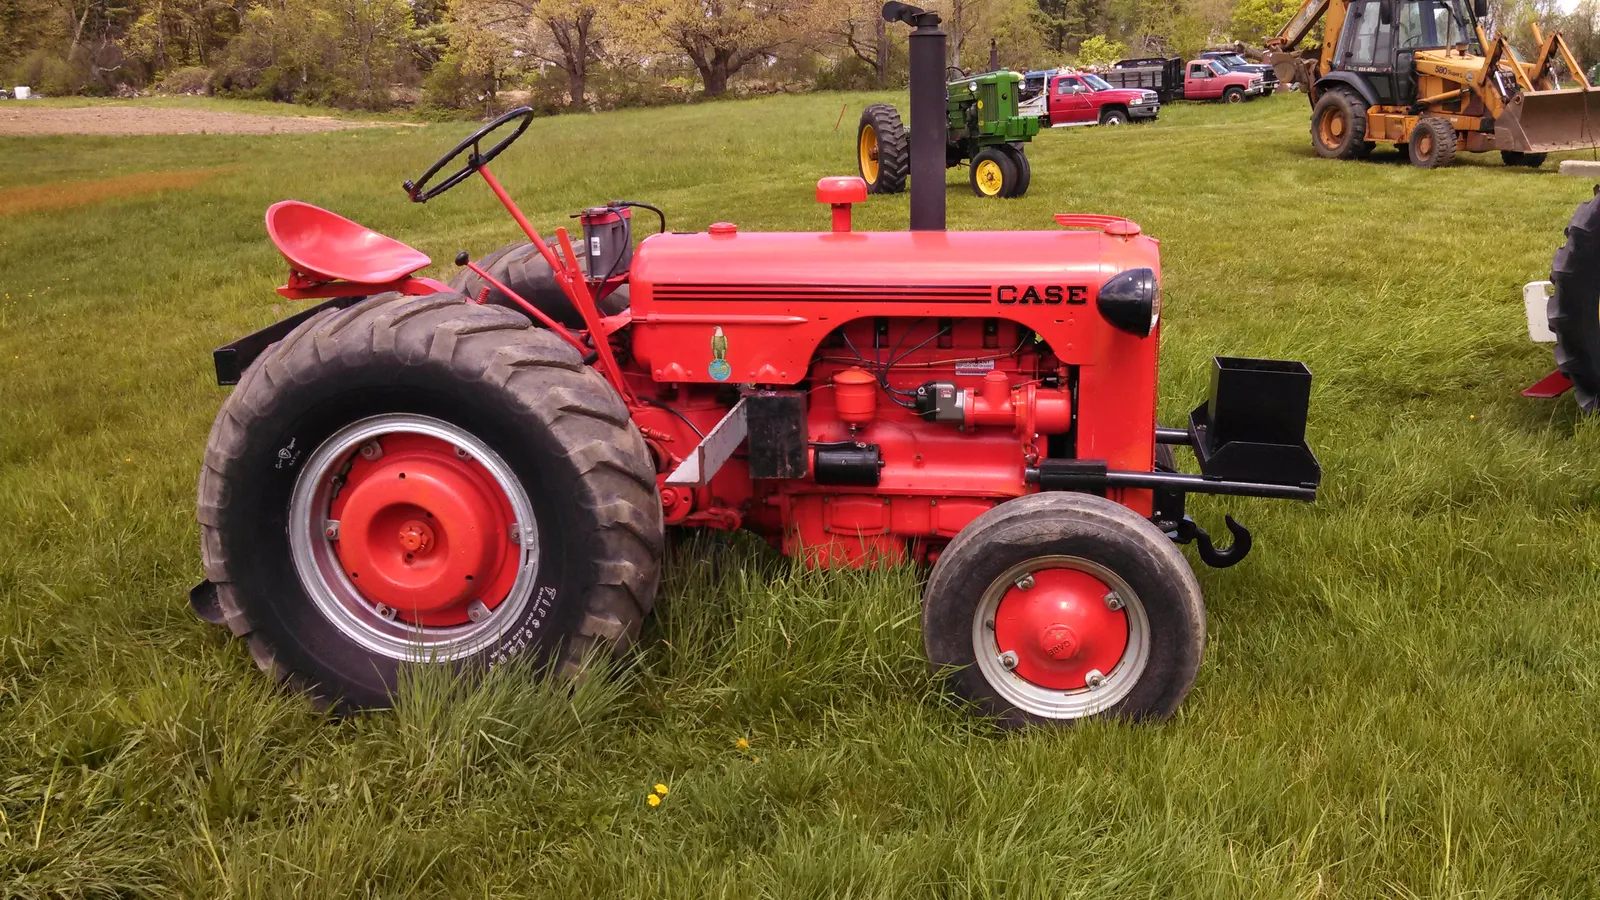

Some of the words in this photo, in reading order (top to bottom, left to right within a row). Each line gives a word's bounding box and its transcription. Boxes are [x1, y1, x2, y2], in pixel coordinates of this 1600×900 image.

[1435, 65, 1447, 75] 580
[997, 285, 1087, 304] CASE
[533, 587, 544, 611] GROUND
[525, 612, 534, 625] GRIP
[512, 626, 525, 640] ROAD
[490, 640, 512, 659] BUILER
